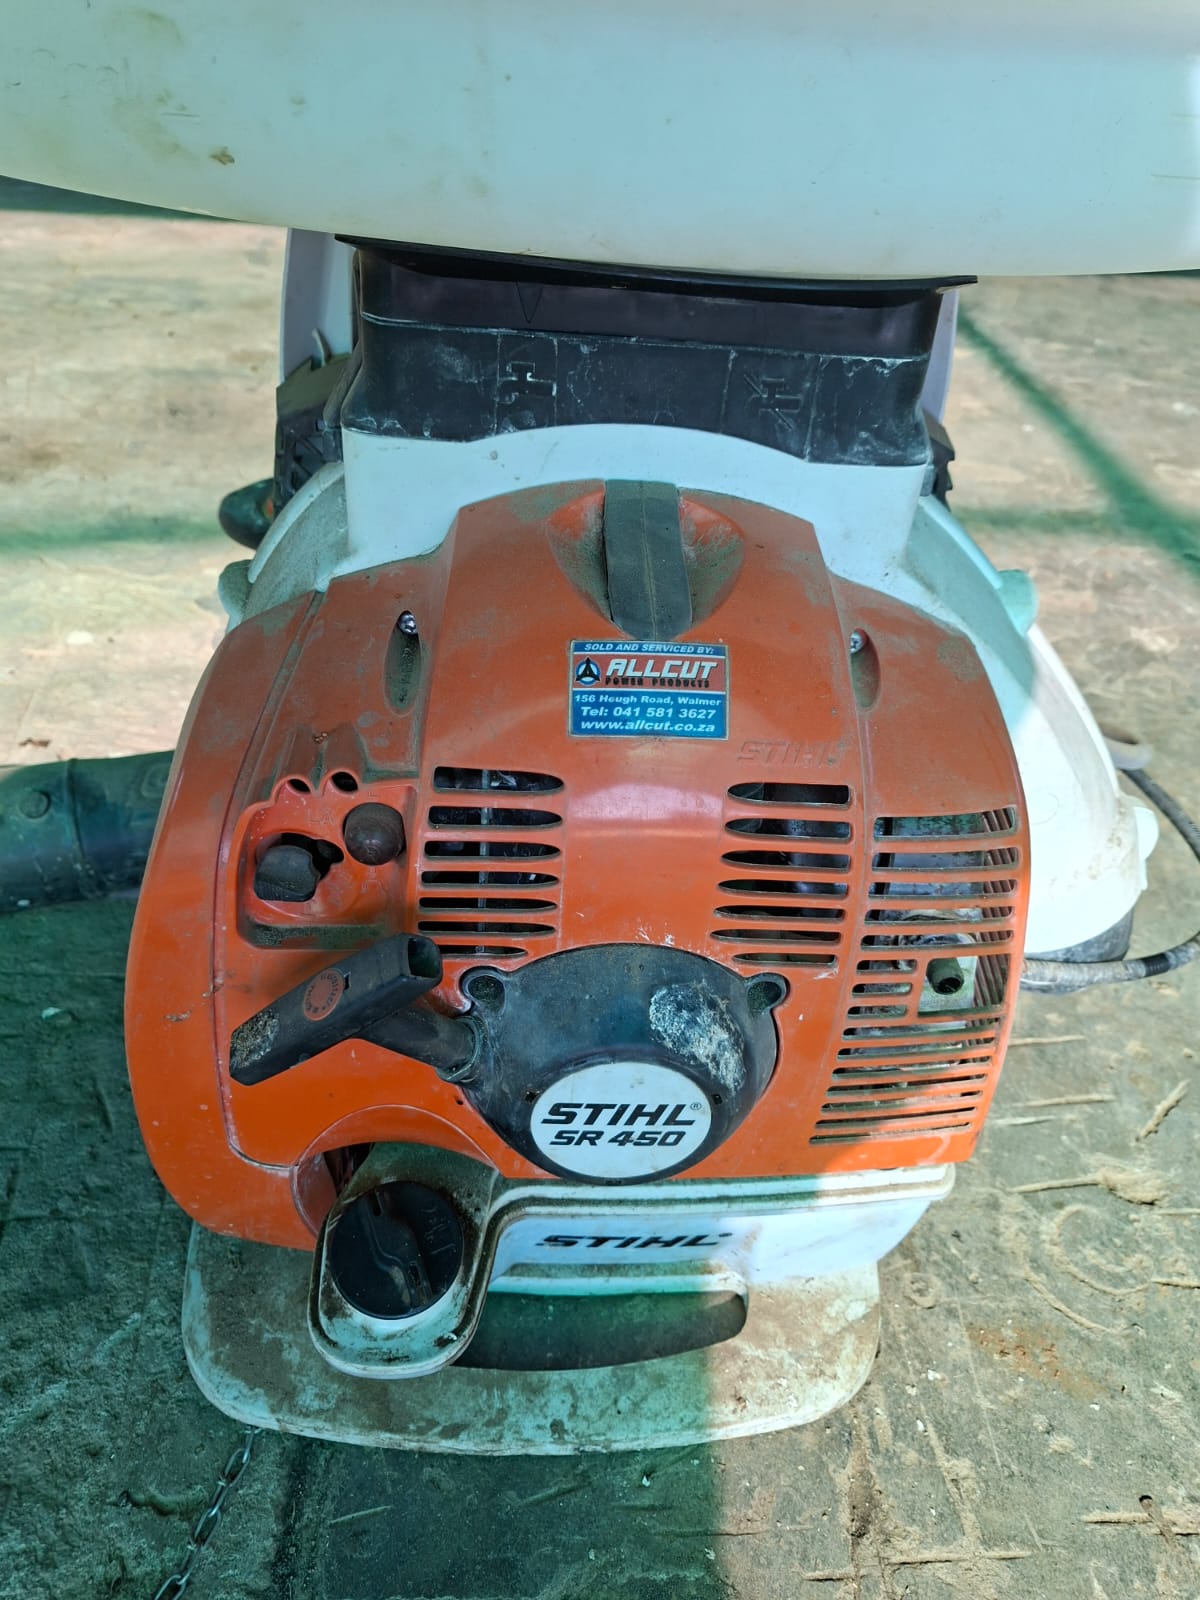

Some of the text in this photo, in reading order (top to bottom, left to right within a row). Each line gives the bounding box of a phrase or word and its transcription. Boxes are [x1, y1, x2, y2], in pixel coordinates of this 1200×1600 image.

[585, 643, 613, 651] SOLD
[641, 644, 694, 653] SERVICED
[606, 659, 718, 679] ALLCUT
[605, 677, 710, 688] POWER PRODUCTS
[641, 696, 674, 705] Road,
[678, 697, 722, 706] Walmer
[581, 707, 716, 719] Tel: 041 581 3627
[581, 720, 715, 732] www.allcut.co.za
[549, 1130, 686, 1146] SR 450
